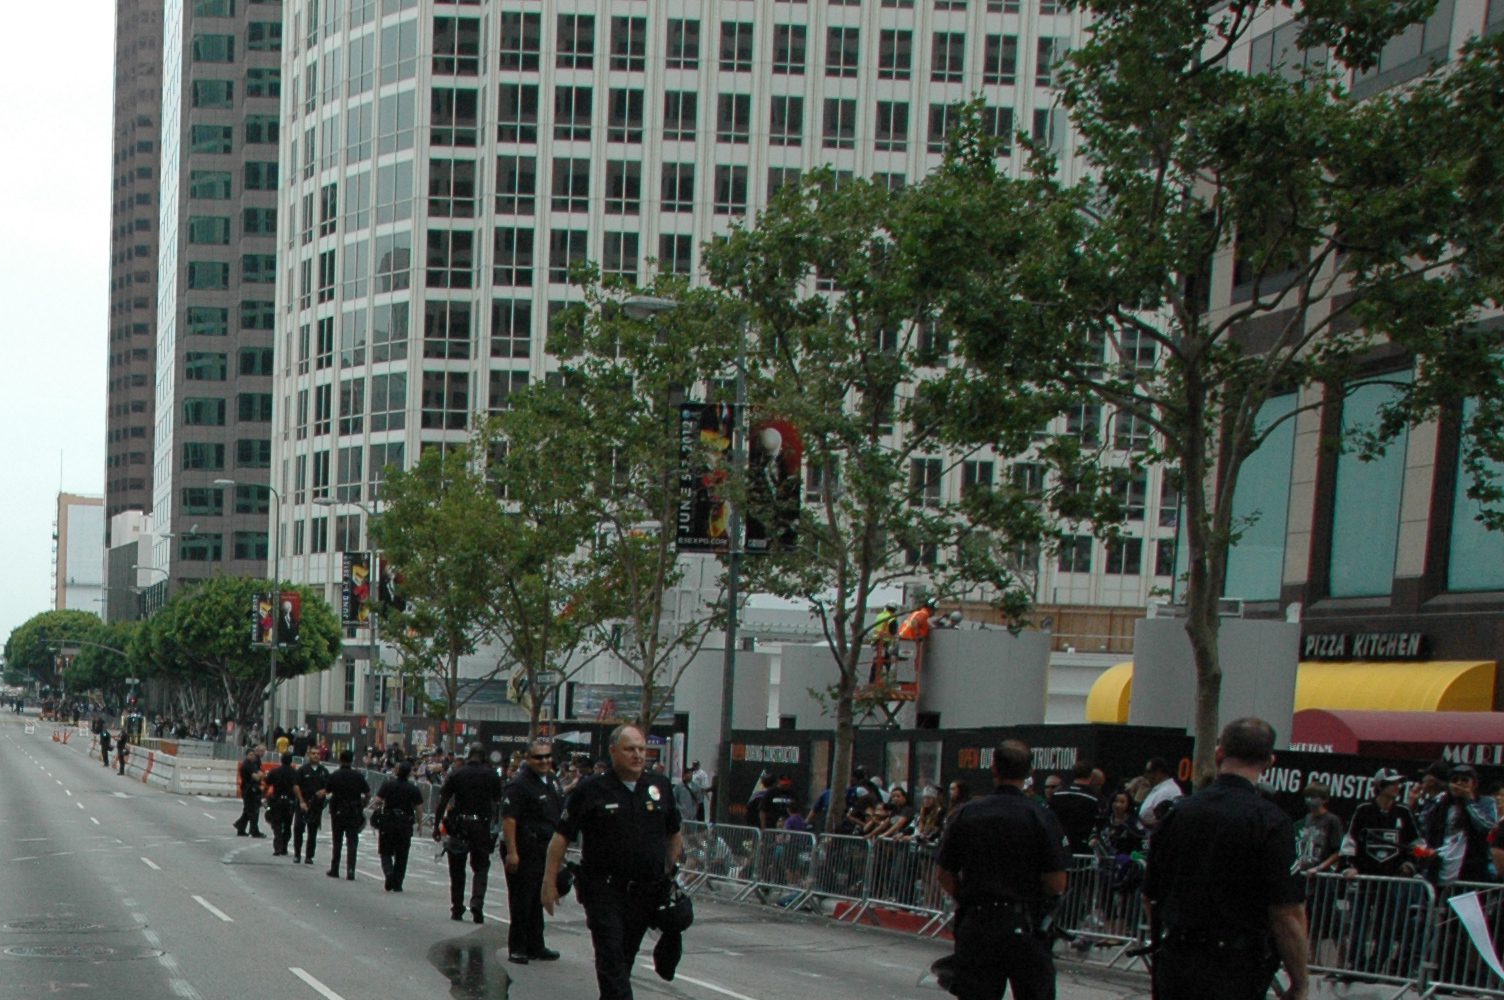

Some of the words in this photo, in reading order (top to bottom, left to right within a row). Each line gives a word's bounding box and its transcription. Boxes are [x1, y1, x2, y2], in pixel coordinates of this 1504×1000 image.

[682, 420, 693, 453] 2012
[680, 487, 692, 534] JUNE
[1304, 634, 1346, 656] PIZZA
[1352, 633, 1422, 656] KITCHEN
